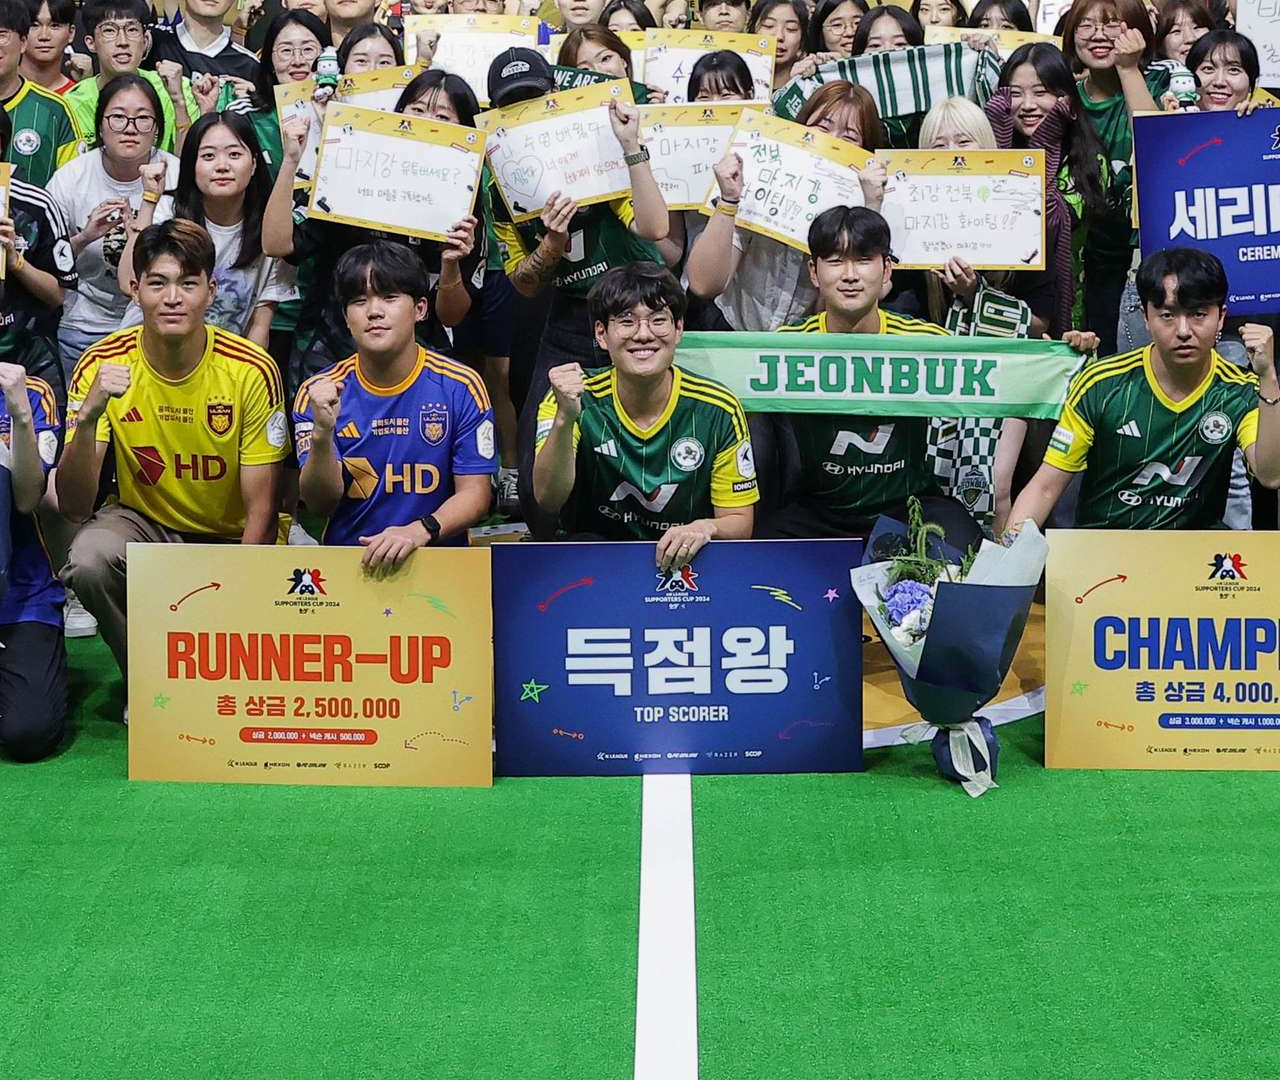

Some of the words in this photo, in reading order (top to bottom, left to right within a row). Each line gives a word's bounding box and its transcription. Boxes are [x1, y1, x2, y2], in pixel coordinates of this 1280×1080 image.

[554, 69, 572, 87] WE
[750, 143, 783, 165] 전북
[563, 261, 609, 285] HYUNDAI
[749, 353, 998, 397] JEONBUK
[174, 454, 227, 482] HD
[384, 463, 441, 494] HD
[846, 460, 905, 477] HYUNDAI
[166, 631, 452, 685] RUNNER-UP
[565, 624, 796, 697] 득점왕
[1135, 681, 1157, 703] 총
[1163, 681, 1206, 704] 상금
[216, 695, 238, 717] 총
[245, 695, 287, 718] 상금
[293, 696, 401, 720] 2,500,000
[634, 706, 664, 723] TOP
[668, 705, 729, 722] SCORER
